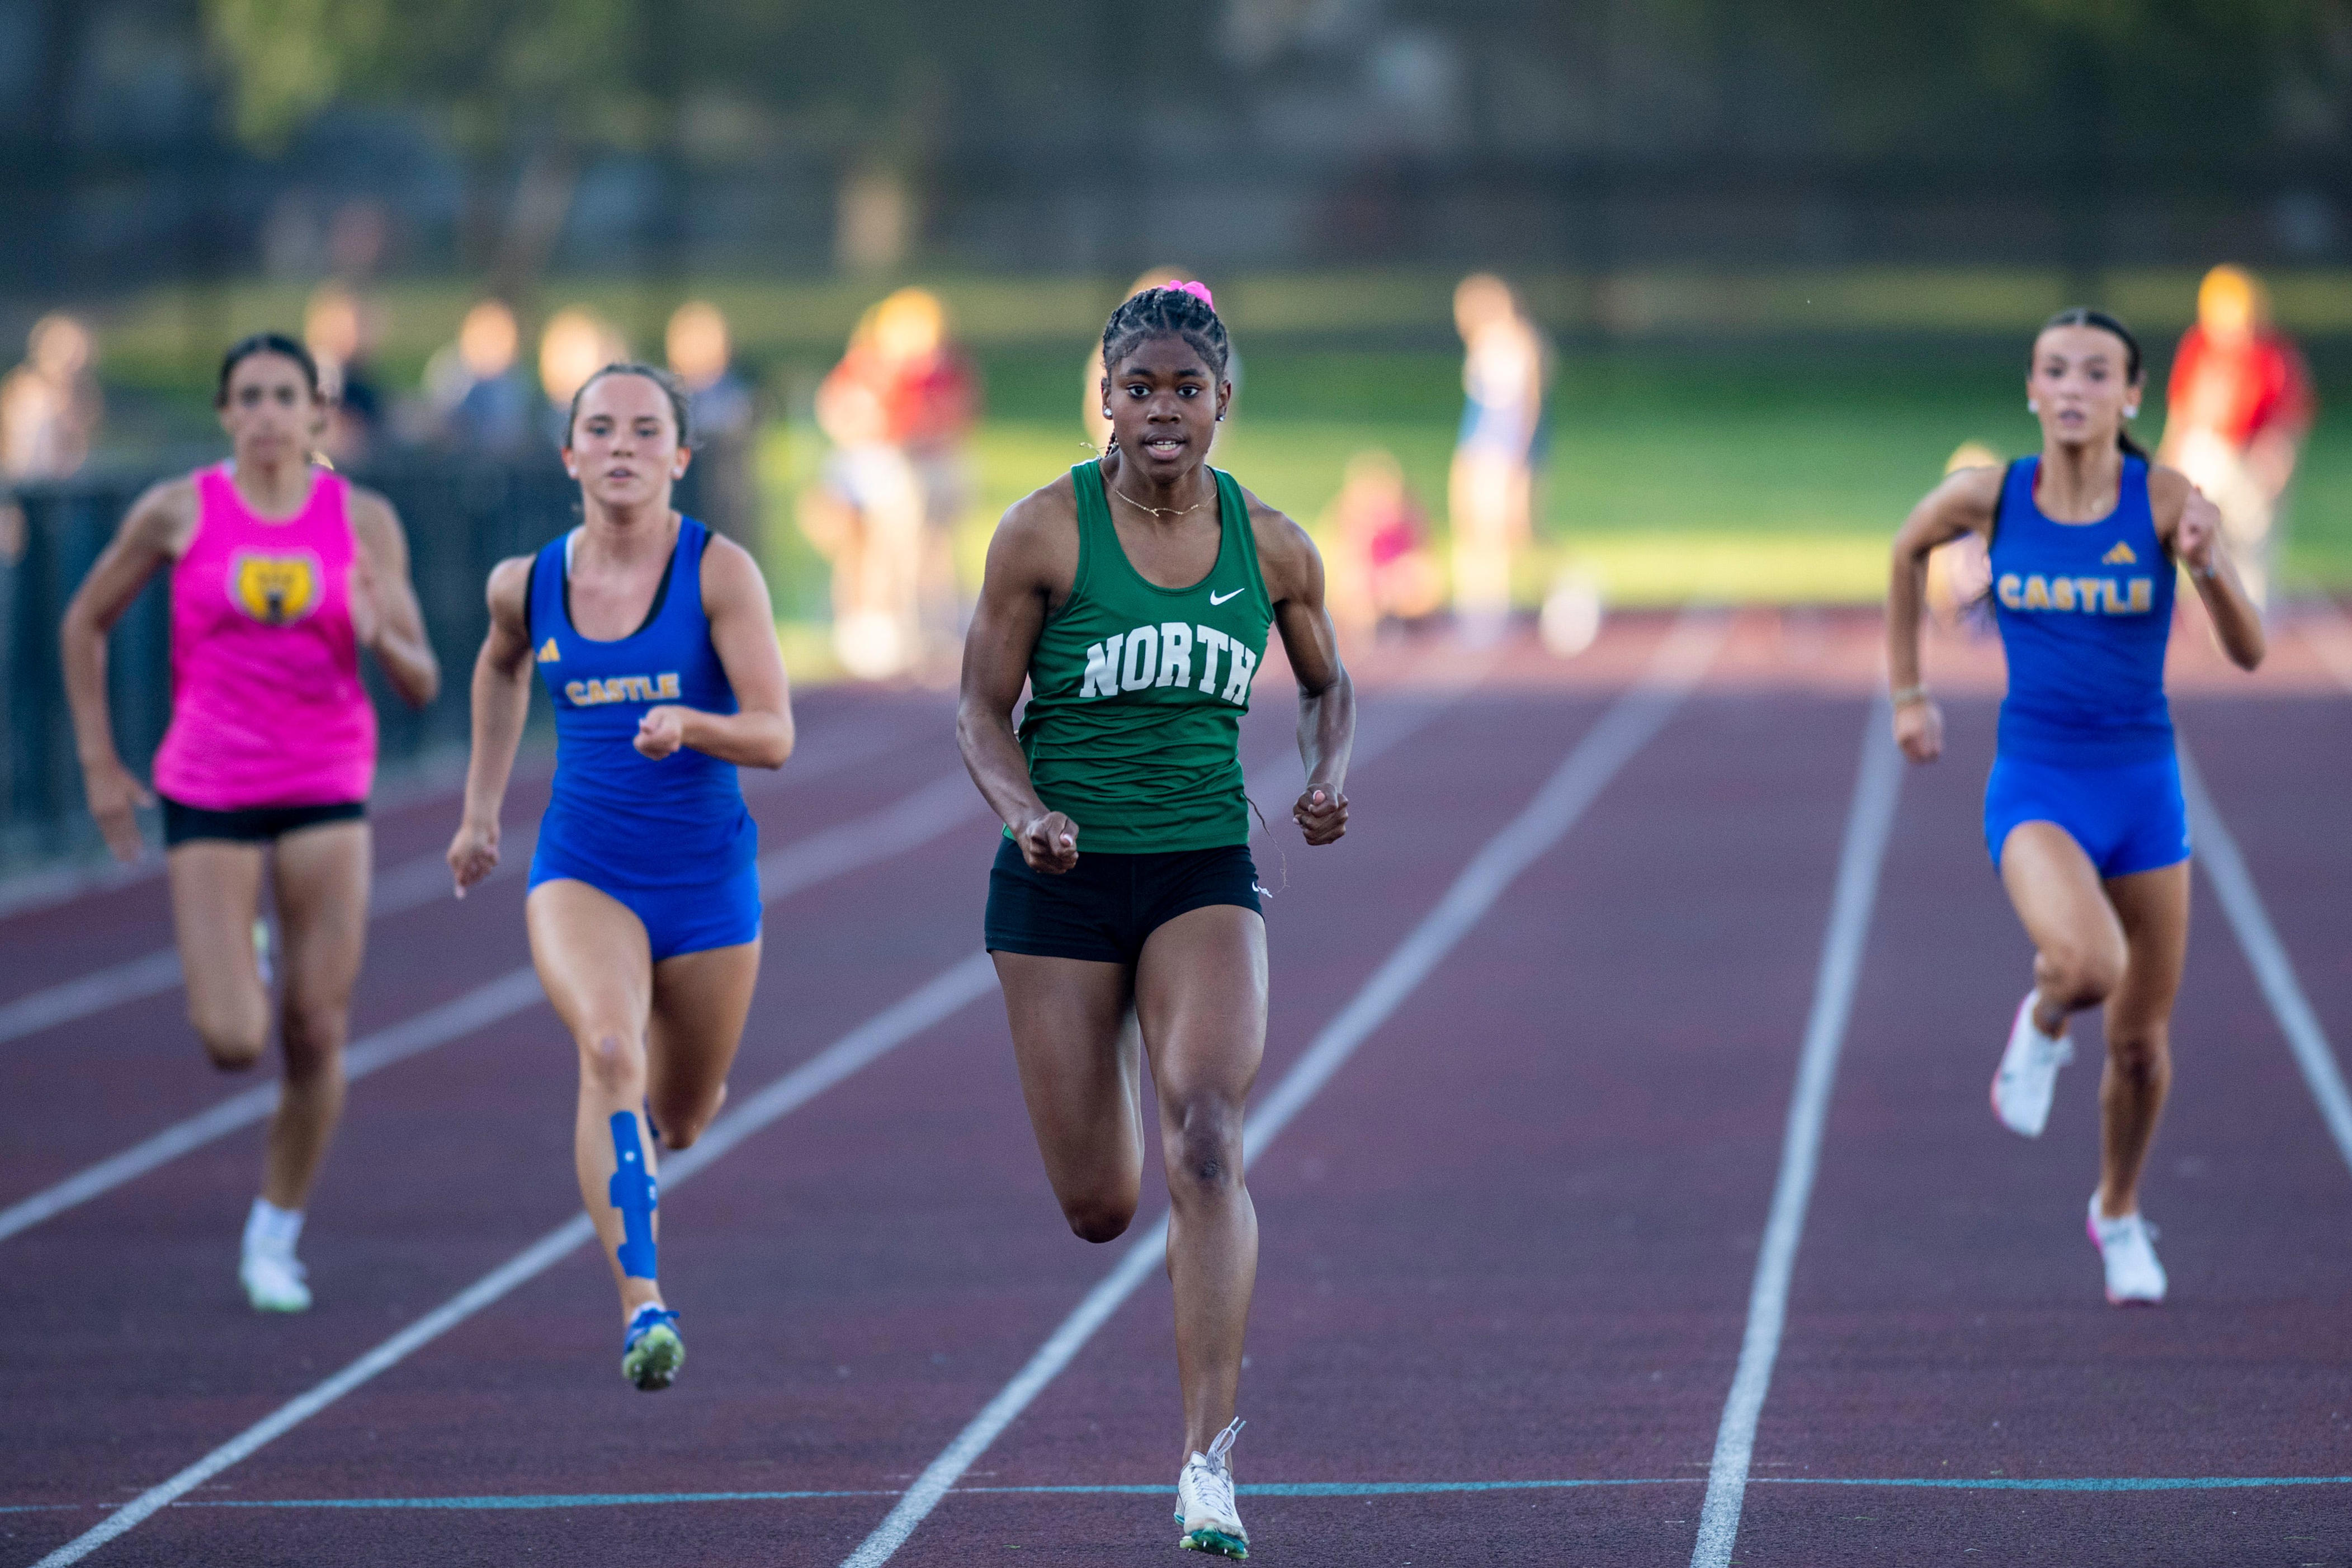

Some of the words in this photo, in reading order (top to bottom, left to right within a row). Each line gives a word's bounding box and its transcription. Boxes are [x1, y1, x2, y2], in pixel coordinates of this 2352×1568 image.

[1999, 574, 2151, 613] CASTLE
[1079, 622, 1257, 706] NORTH
[565, 673, 680, 706] CASTLE
